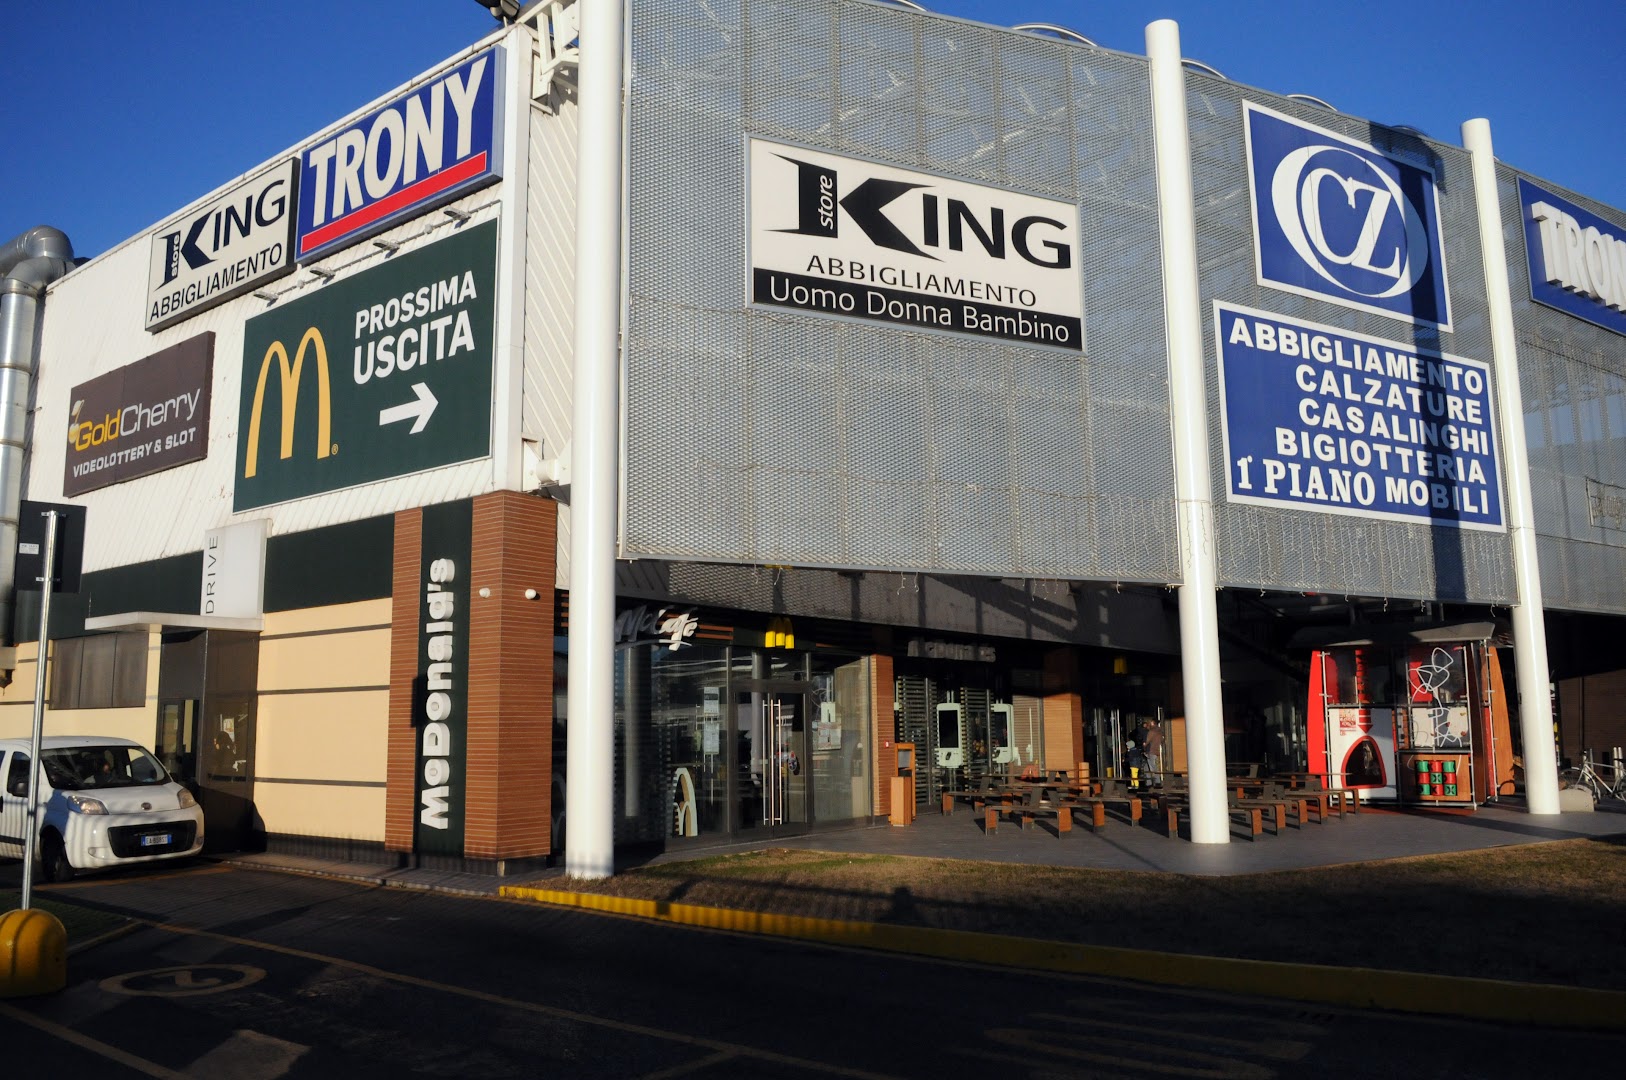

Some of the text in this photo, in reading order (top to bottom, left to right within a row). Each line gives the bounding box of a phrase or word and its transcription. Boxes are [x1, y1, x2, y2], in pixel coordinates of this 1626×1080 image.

[309, 56, 488, 228] TRONY
[154, 179, 286, 292] KING
[763, 152, 1072, 270] KING
[818, 174, 834, 230] store
[150, 242, 282, 322] ABBIGLIAMENTO
[171, 234, 180, 277] store
[806, 255, 1037, 307] ABBIGLIAMENTO
[355, 270, 477, 339] PROSSIMA
[770, 276, 1069, 343] Uomo Donna Bambino
[354, 310, 475, 384] USCITA
[1229, 317, 1483, 395] ABBIGLIAMENTO
[1296, 364, 1482, 426] CALZATURE
[1298, 398, 1489, 455] CASALINGHI
[73, 441, 153, 478] VIDEOLOTTERY
[165, 427, 196, 450] SLOT
[1263, 458, 1376, 506] PIANO
[1385, 476, 1489, 515] MOBILI
[1276, 427, 1486, 485] BIGIOTTERIA
[205, 535, 218, 614] DRIVE
[420, 558, 455, 830] McDonald's
